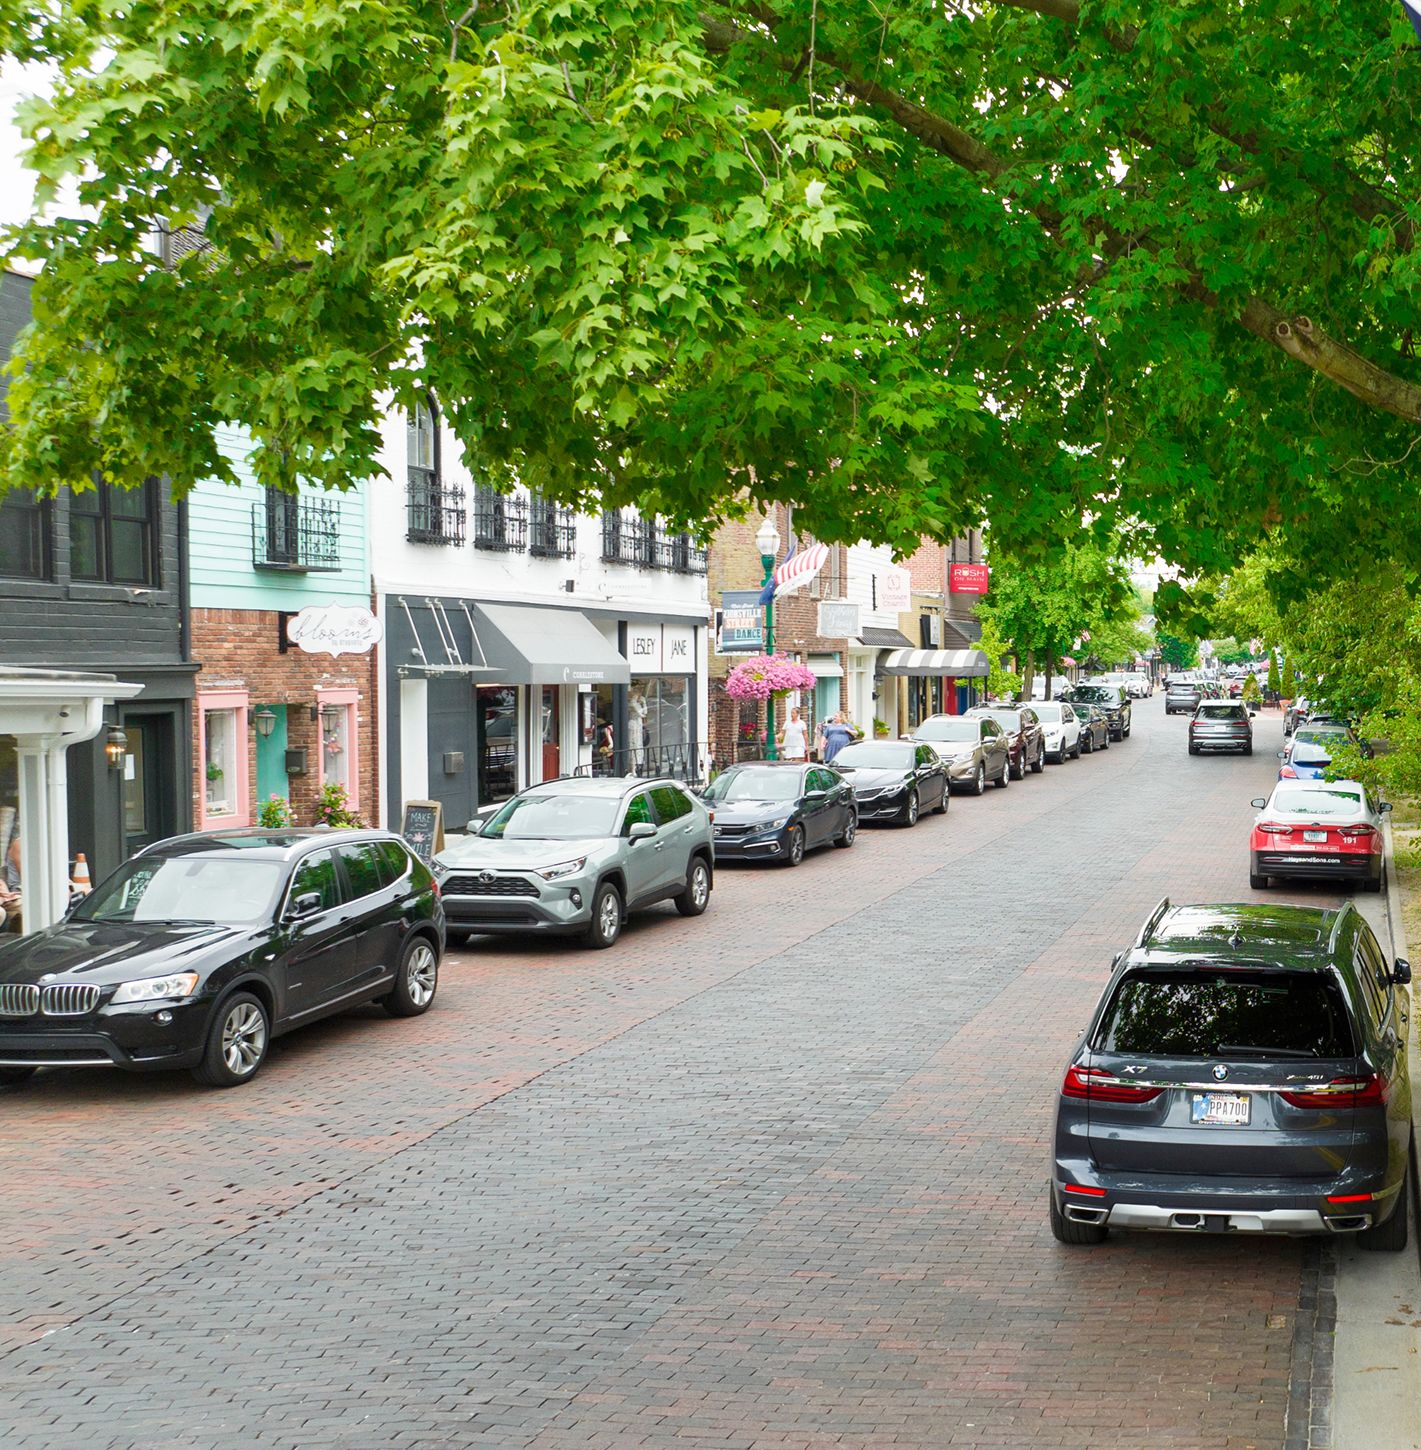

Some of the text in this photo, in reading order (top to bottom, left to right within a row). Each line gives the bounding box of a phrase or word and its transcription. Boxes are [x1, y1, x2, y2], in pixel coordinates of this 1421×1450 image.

[632, 637, 656, 655] LESLEY
[670, 639, 688, 659] JANE
[410, 812, 432, 823] MAKE
[1343, 836, 1357, 844] 191
[1121, 1065, 1148, 1074] X7
[1209, 1101, 1248, 1116] PPA700
